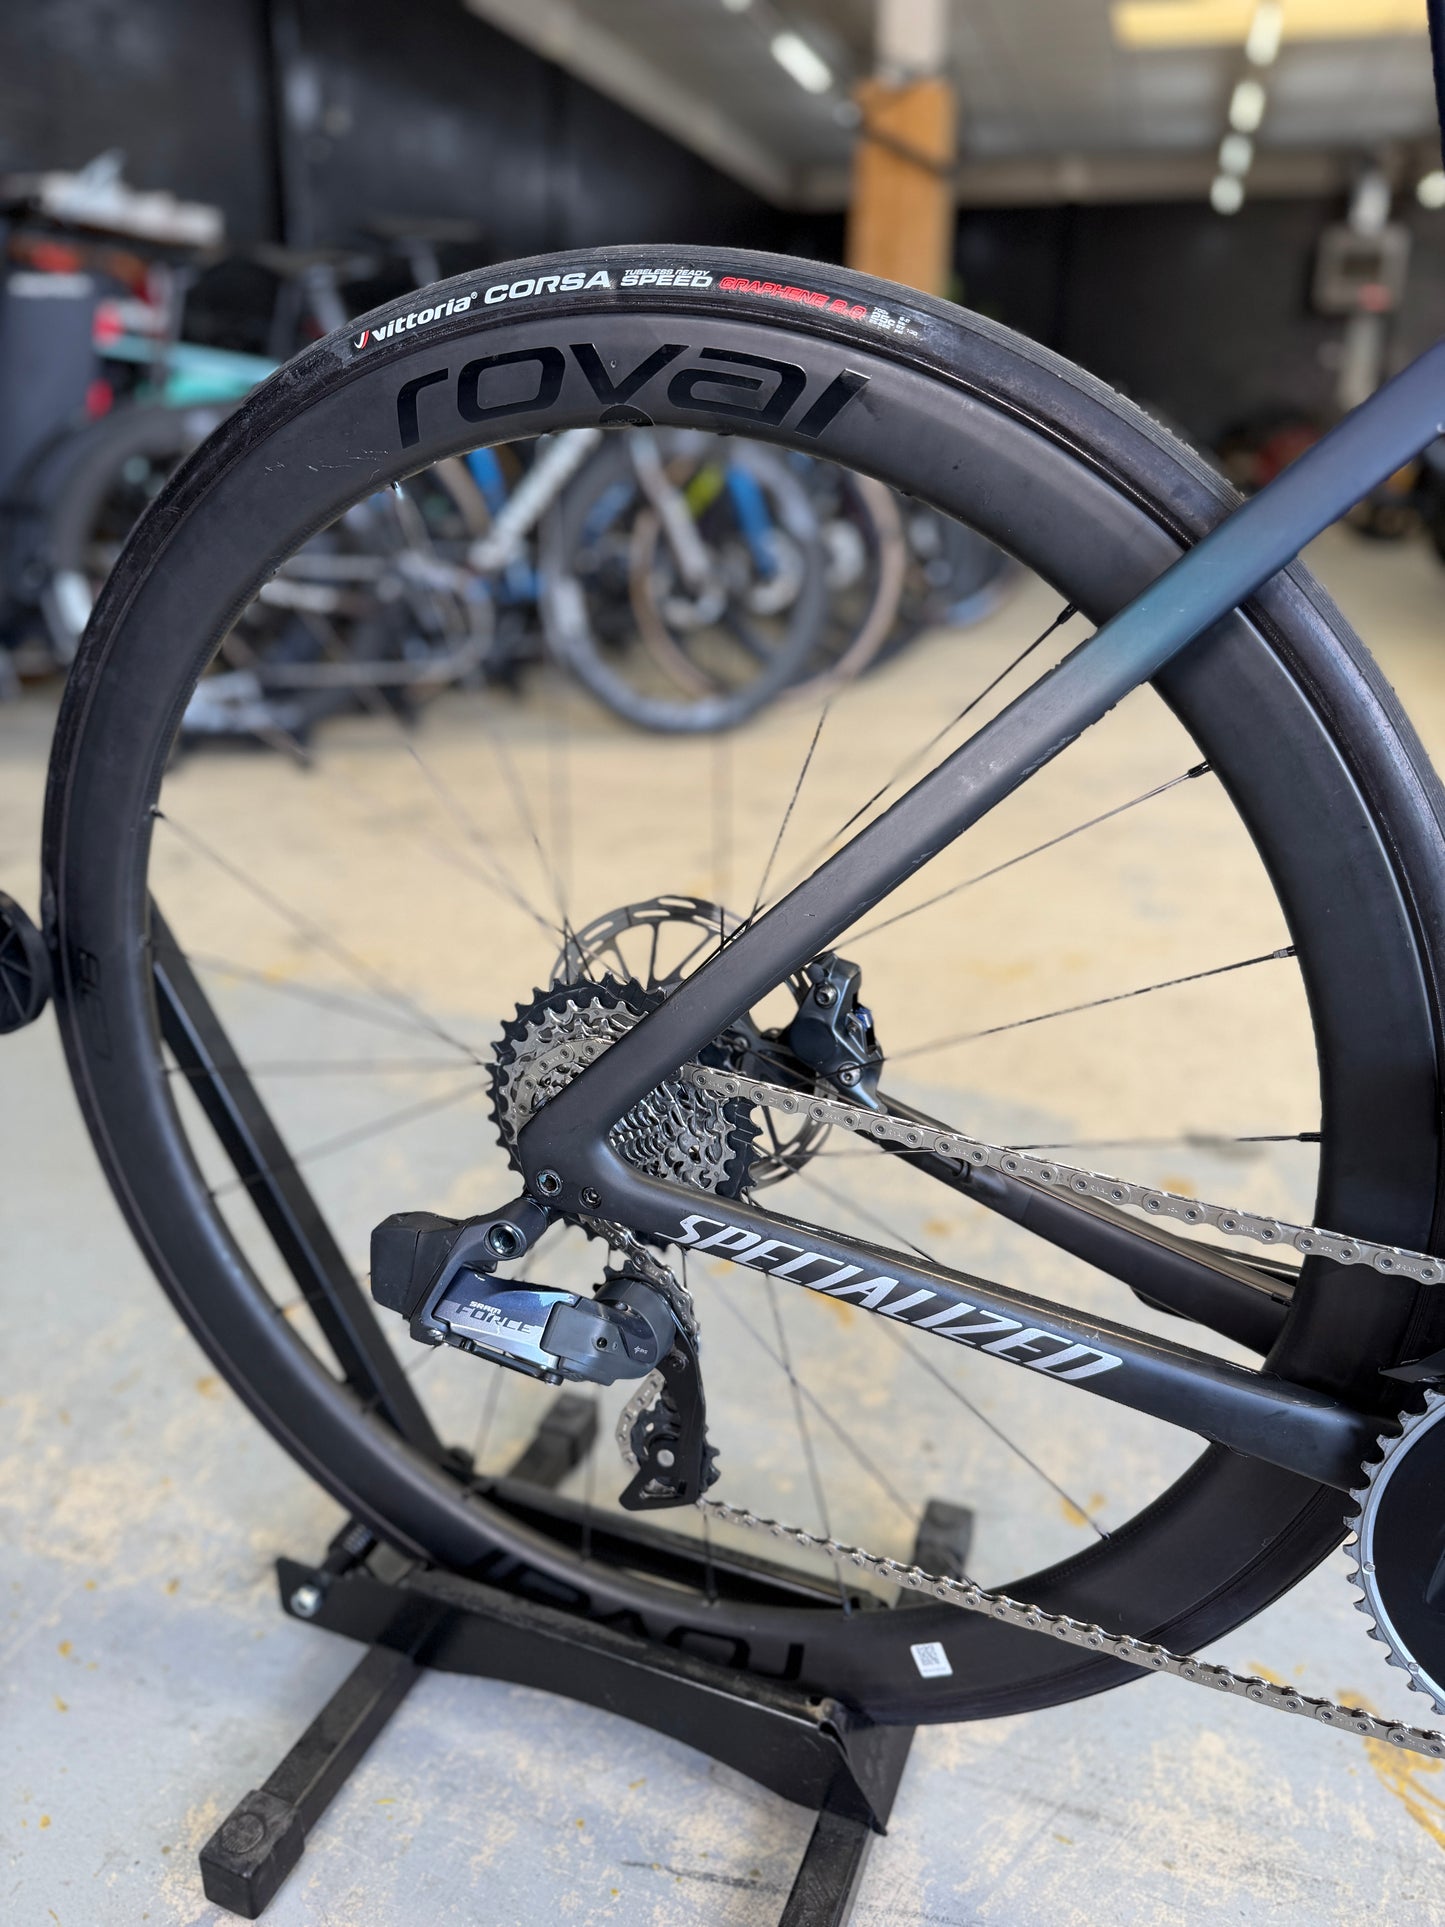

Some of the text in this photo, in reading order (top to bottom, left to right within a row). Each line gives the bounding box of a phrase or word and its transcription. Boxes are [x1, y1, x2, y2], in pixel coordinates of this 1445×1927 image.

[624, 268, 674, 276] TUBELESS
[484, 270, 611, 305] CORSA
[620, 274, 713, 287] SPEED
[718, 276, 830, 308] GRAPHENE
[828, 299, 868, 320] 2.0
[397, 343, 872, 449] roval
[469, 1300, 502, 1315] SRAM
[653, 1214, 1124, 1381] SPECIALIZED
[456, 1304, 532, 1334] FORCE
